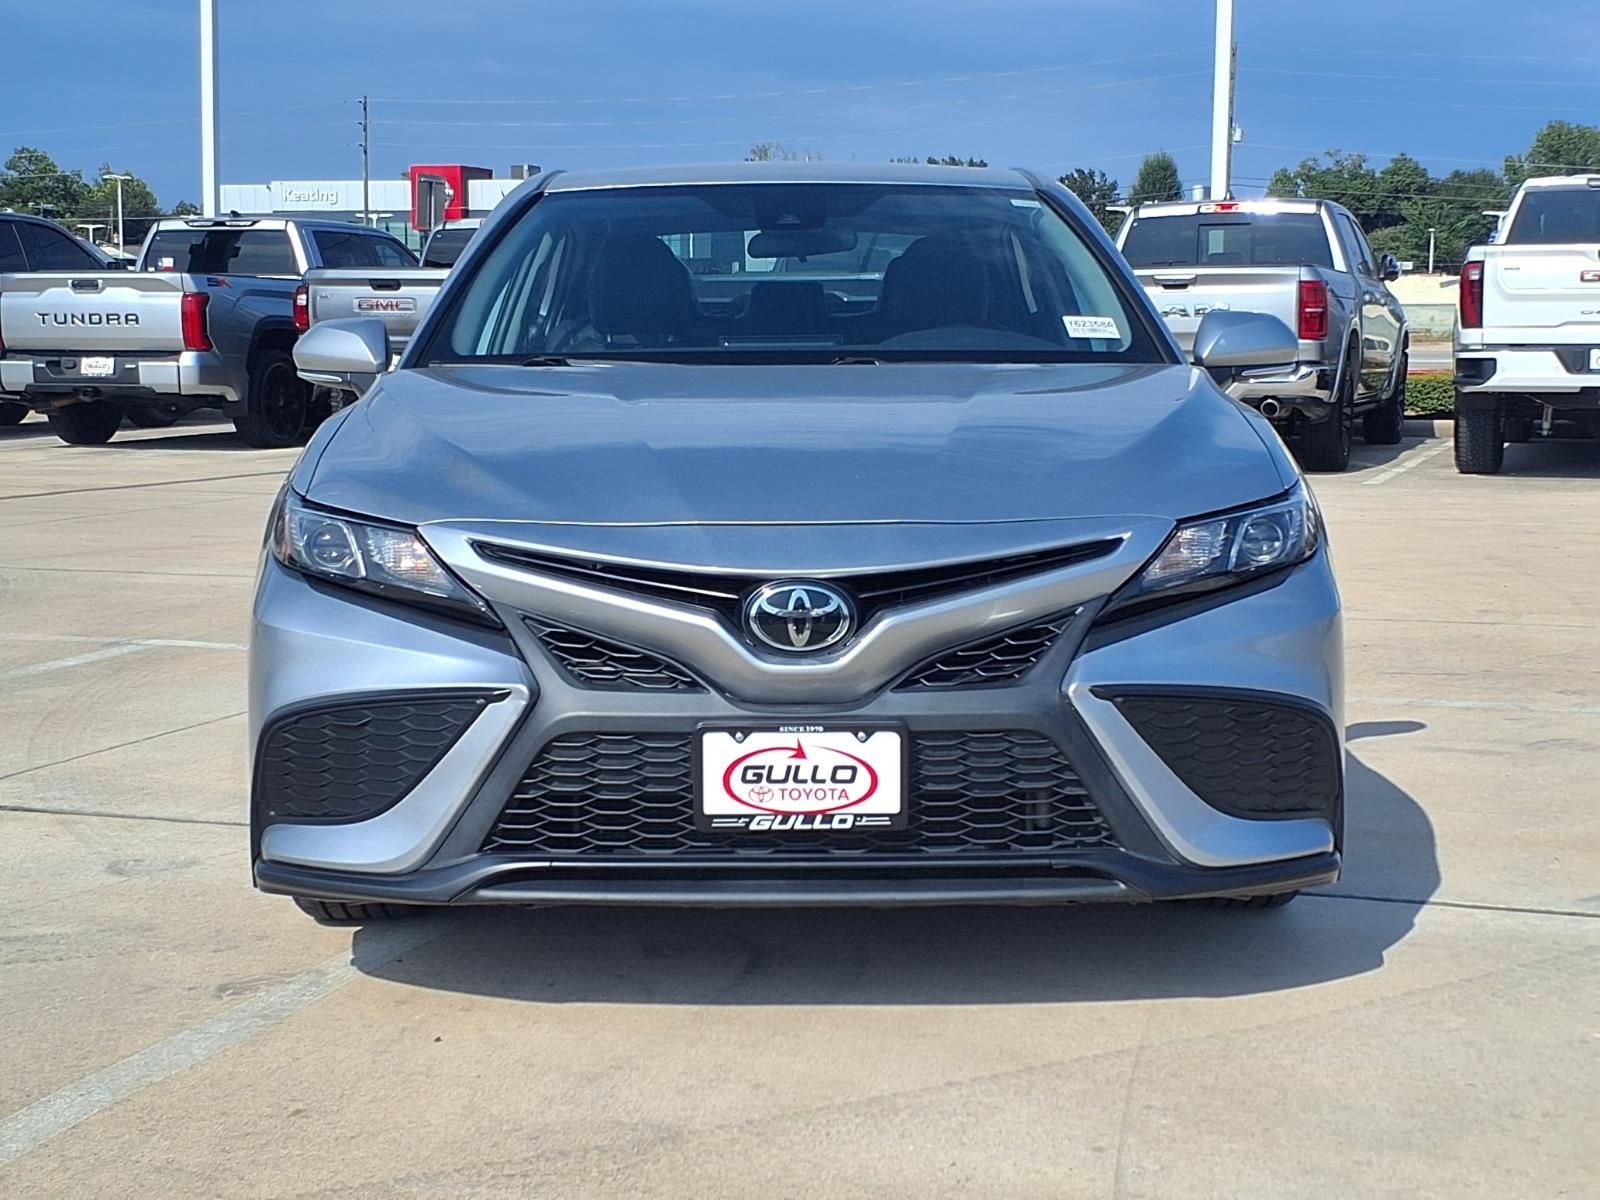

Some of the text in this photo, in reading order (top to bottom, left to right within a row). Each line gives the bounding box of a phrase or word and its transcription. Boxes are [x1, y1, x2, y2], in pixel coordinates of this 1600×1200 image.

[283, 188, 339, 206] Keating
[358, 299, 413, 311] GMC
[36, 312, 141, 327] TUNDRA
[741, 765, 857, 784] GULLO
[778, 788, 850, 801] TOYOTA
[749, 814, 855, 830] GULLO
